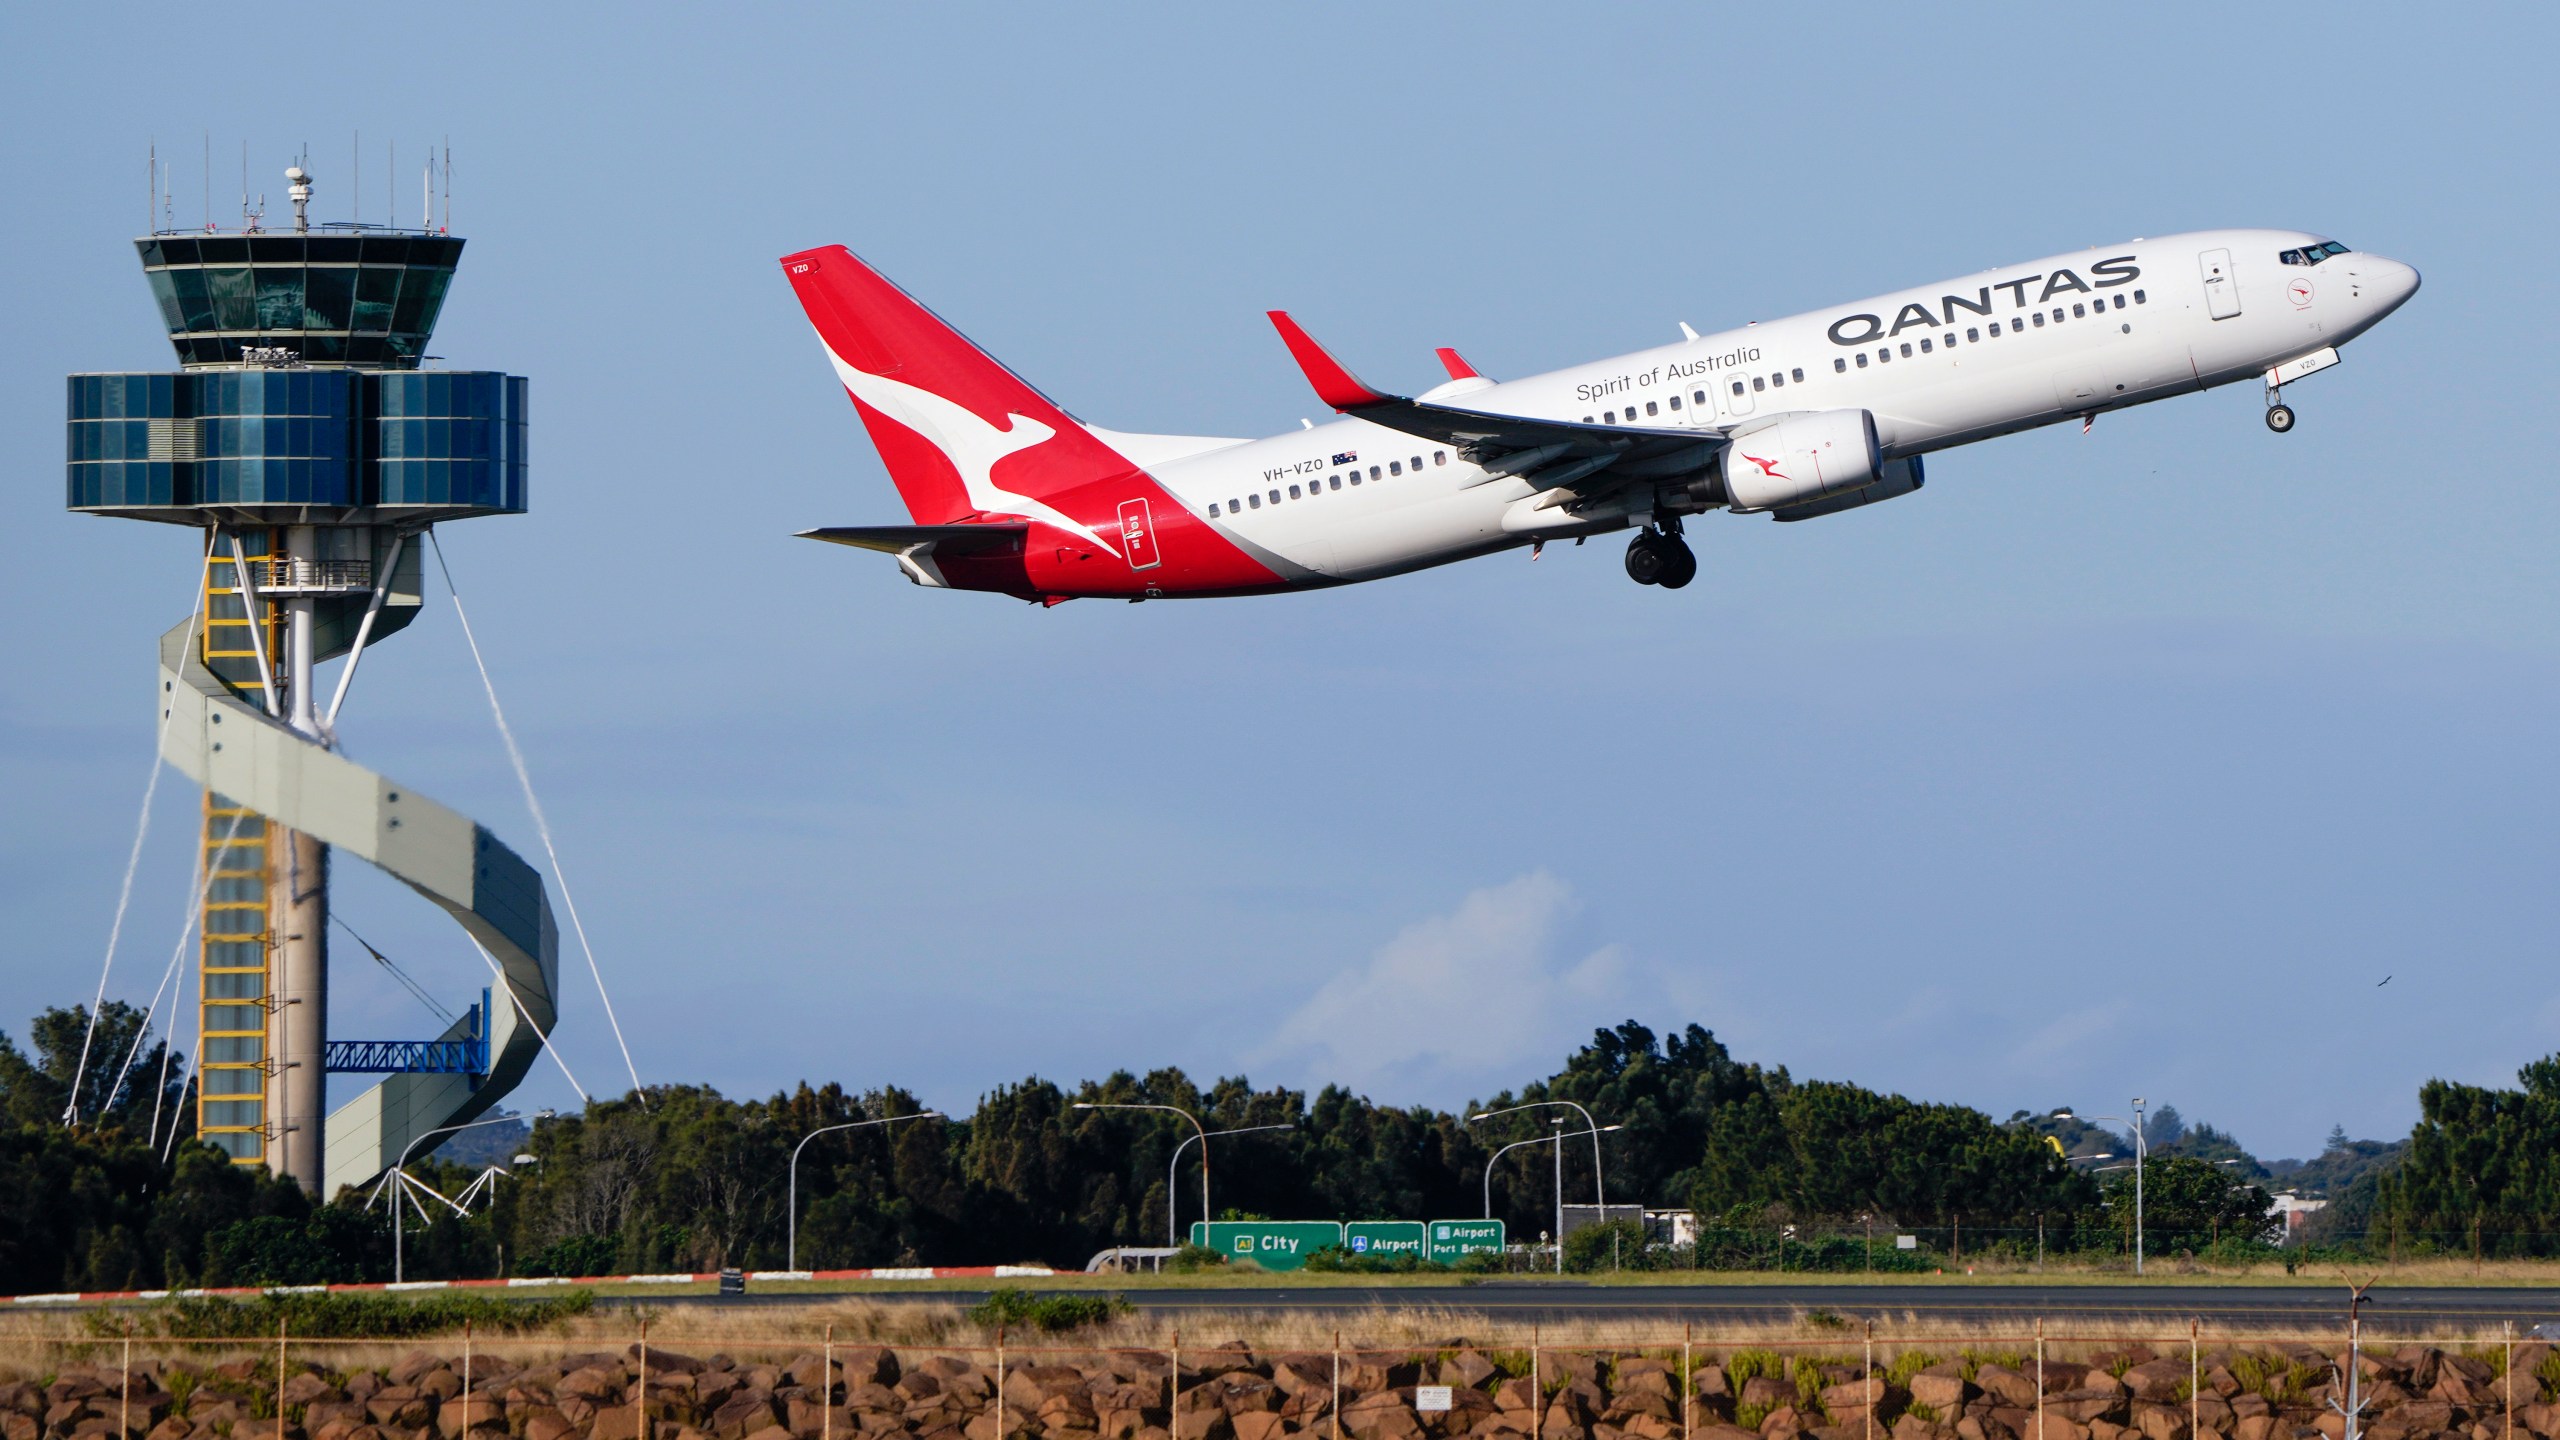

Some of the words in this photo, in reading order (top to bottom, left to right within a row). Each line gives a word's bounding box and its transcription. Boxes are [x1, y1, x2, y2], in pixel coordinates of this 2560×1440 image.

[792, 263, 809, 274] VZO
[1827, 255, 2141, 347] QANTAS
[2300, 359, 2316, 369] VZO
[1576, 375, 1631, 402] Spirit
[1639, 366, 1659, 387] of
[1667, 347, 1761, 380] Australia
[1263, 458, 1323, 482] VH-VZO
[1453, 1227, 1496, 1239] Airport
[1261, 1235, 1299, 1254] City
[1372, 1239, 1419, 1252] Airport
[1433, 1244, 1456, 1253] Port
